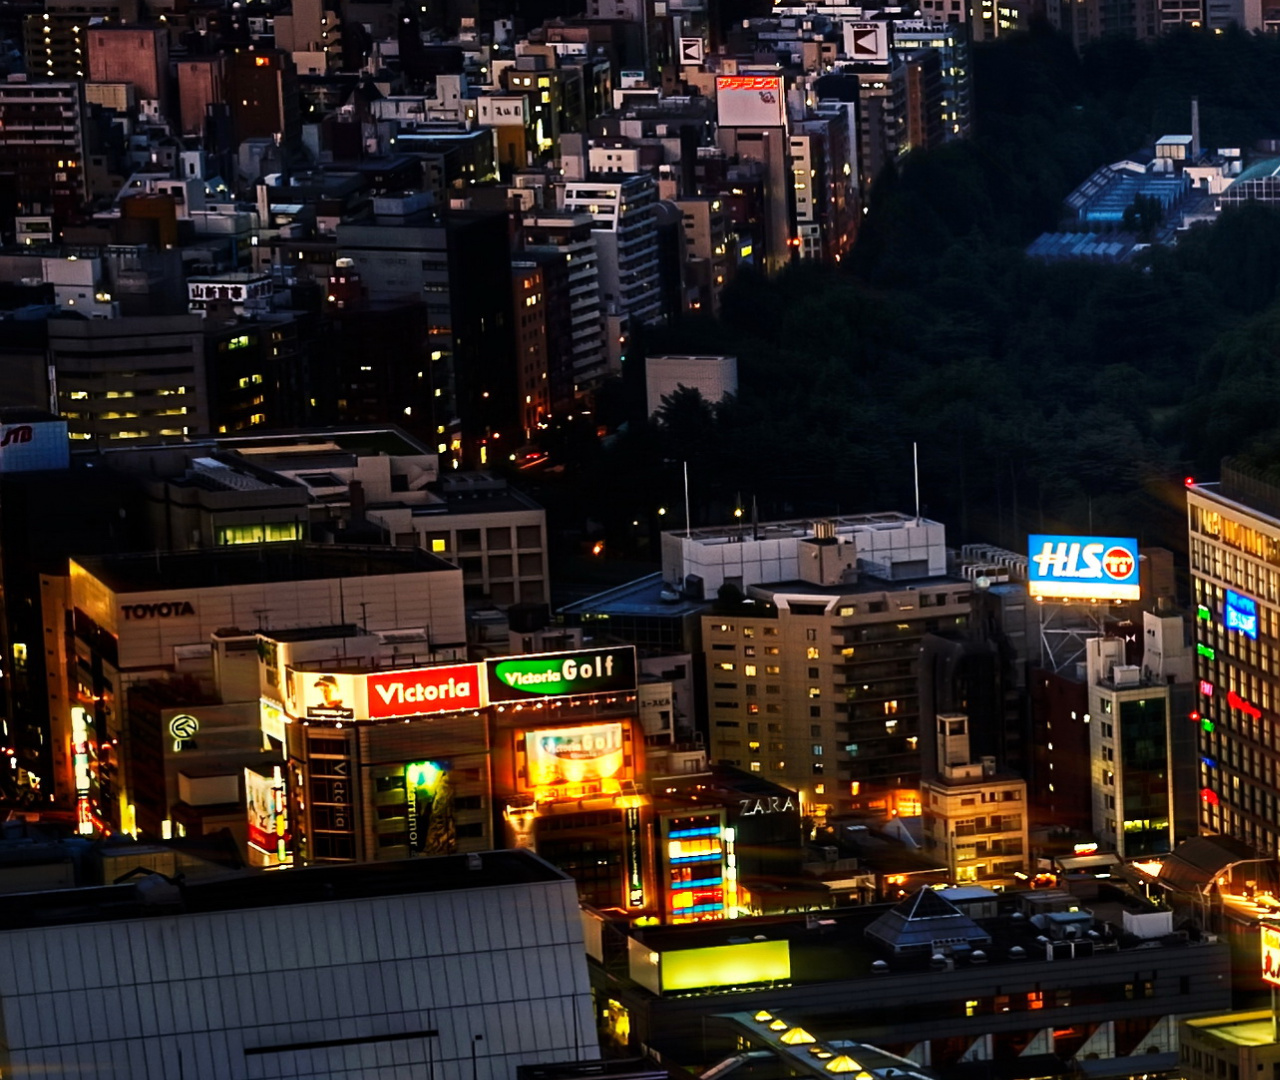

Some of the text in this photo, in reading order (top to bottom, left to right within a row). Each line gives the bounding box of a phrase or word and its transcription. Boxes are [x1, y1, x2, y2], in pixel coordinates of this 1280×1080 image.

[0, 425, 33, 447] JTB
[121, 601, 195, 620] TOYOTA
[504, 654, 614, 687] Victoria Golf
[374, 677, 471, 705] Victoria
[333, 762, 346, 827] Vctoria
[739, 796, 795, 816] ZARA
[407, 784, 419, 847] arrimor
